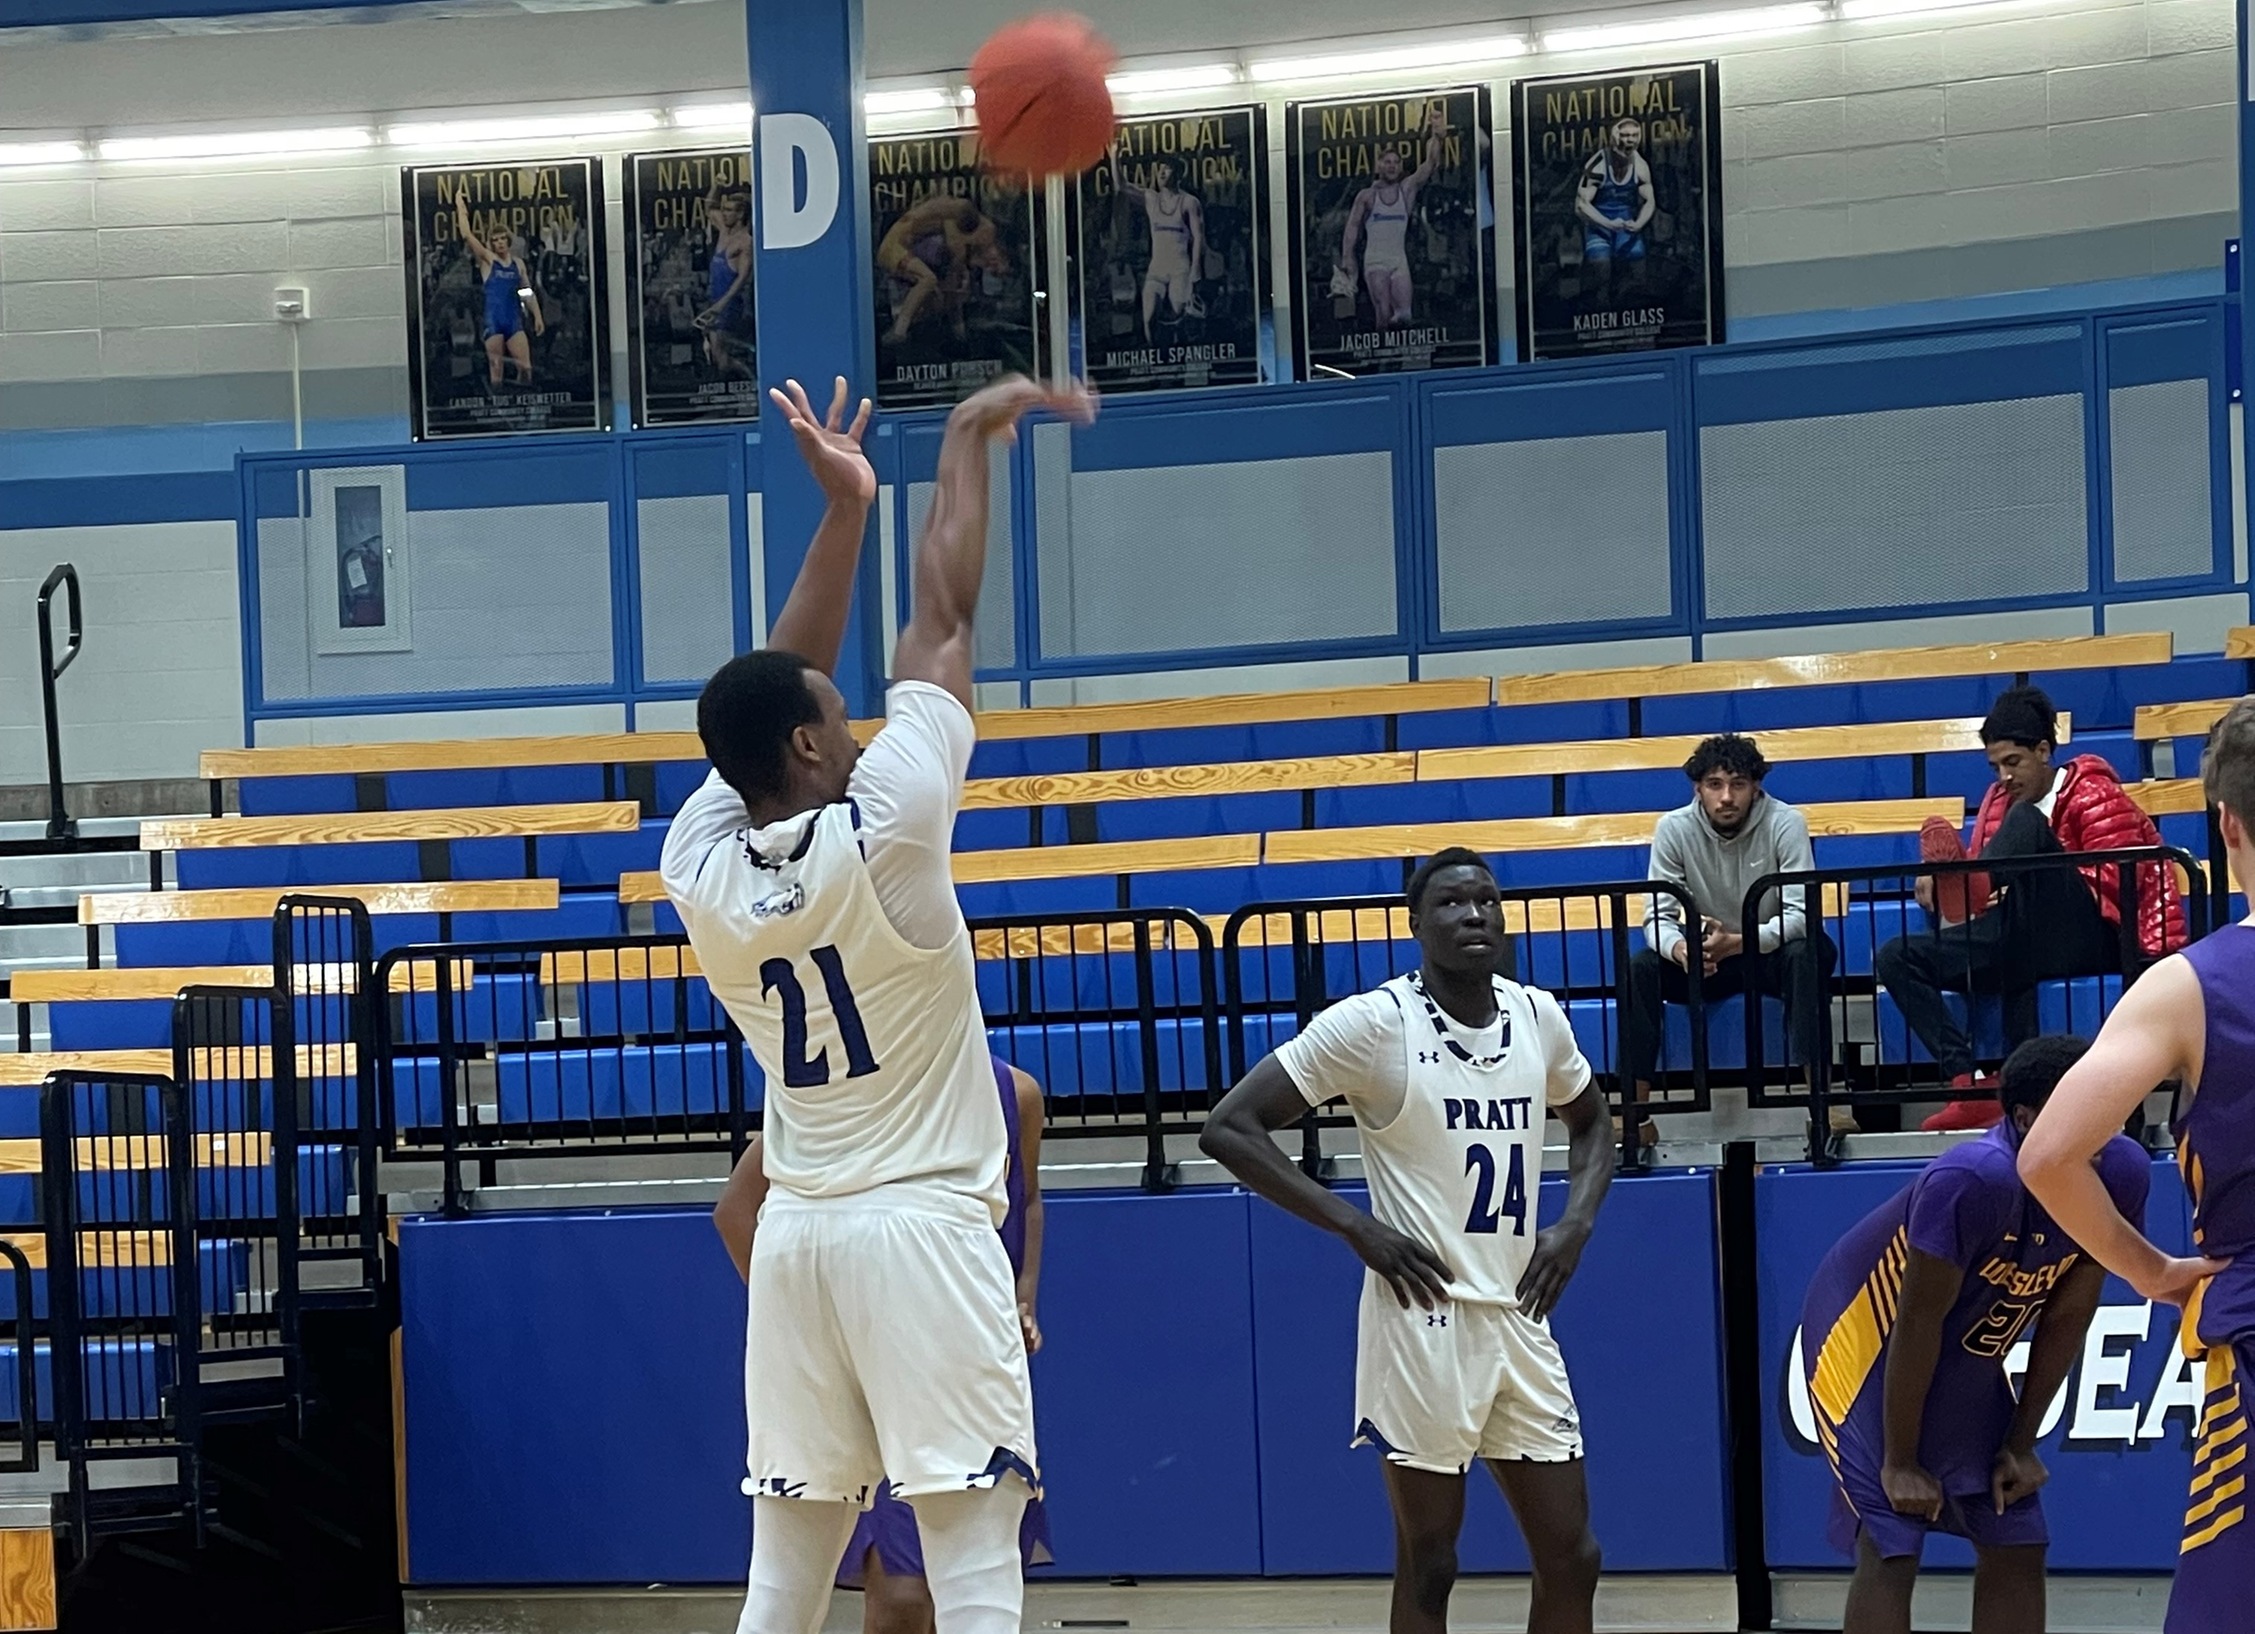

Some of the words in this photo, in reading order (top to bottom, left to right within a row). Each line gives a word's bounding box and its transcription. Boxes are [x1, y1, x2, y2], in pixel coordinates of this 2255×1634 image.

[1117, 117, 1232, 158] ATIONAL
[760, 113, 840, 250] D
[1573, 312, 1618, 332] KADEN
[1622, 307, 1665, 327] GLASS
[1106, 348, 1164, 368] MICHAEL
[1168, 343, 1236, 364] SPANGLER
[1340, 331, 1381, 352] JACOB
[1384, 327, 1450, 348] MITCHELL
[896, 363, 948, 383] DAYTON
[759, 944, 880, 1088] 21
[1443, 1096, 1532, 1131] PRATT
[1464, 1143, 1527, 1237] 24
